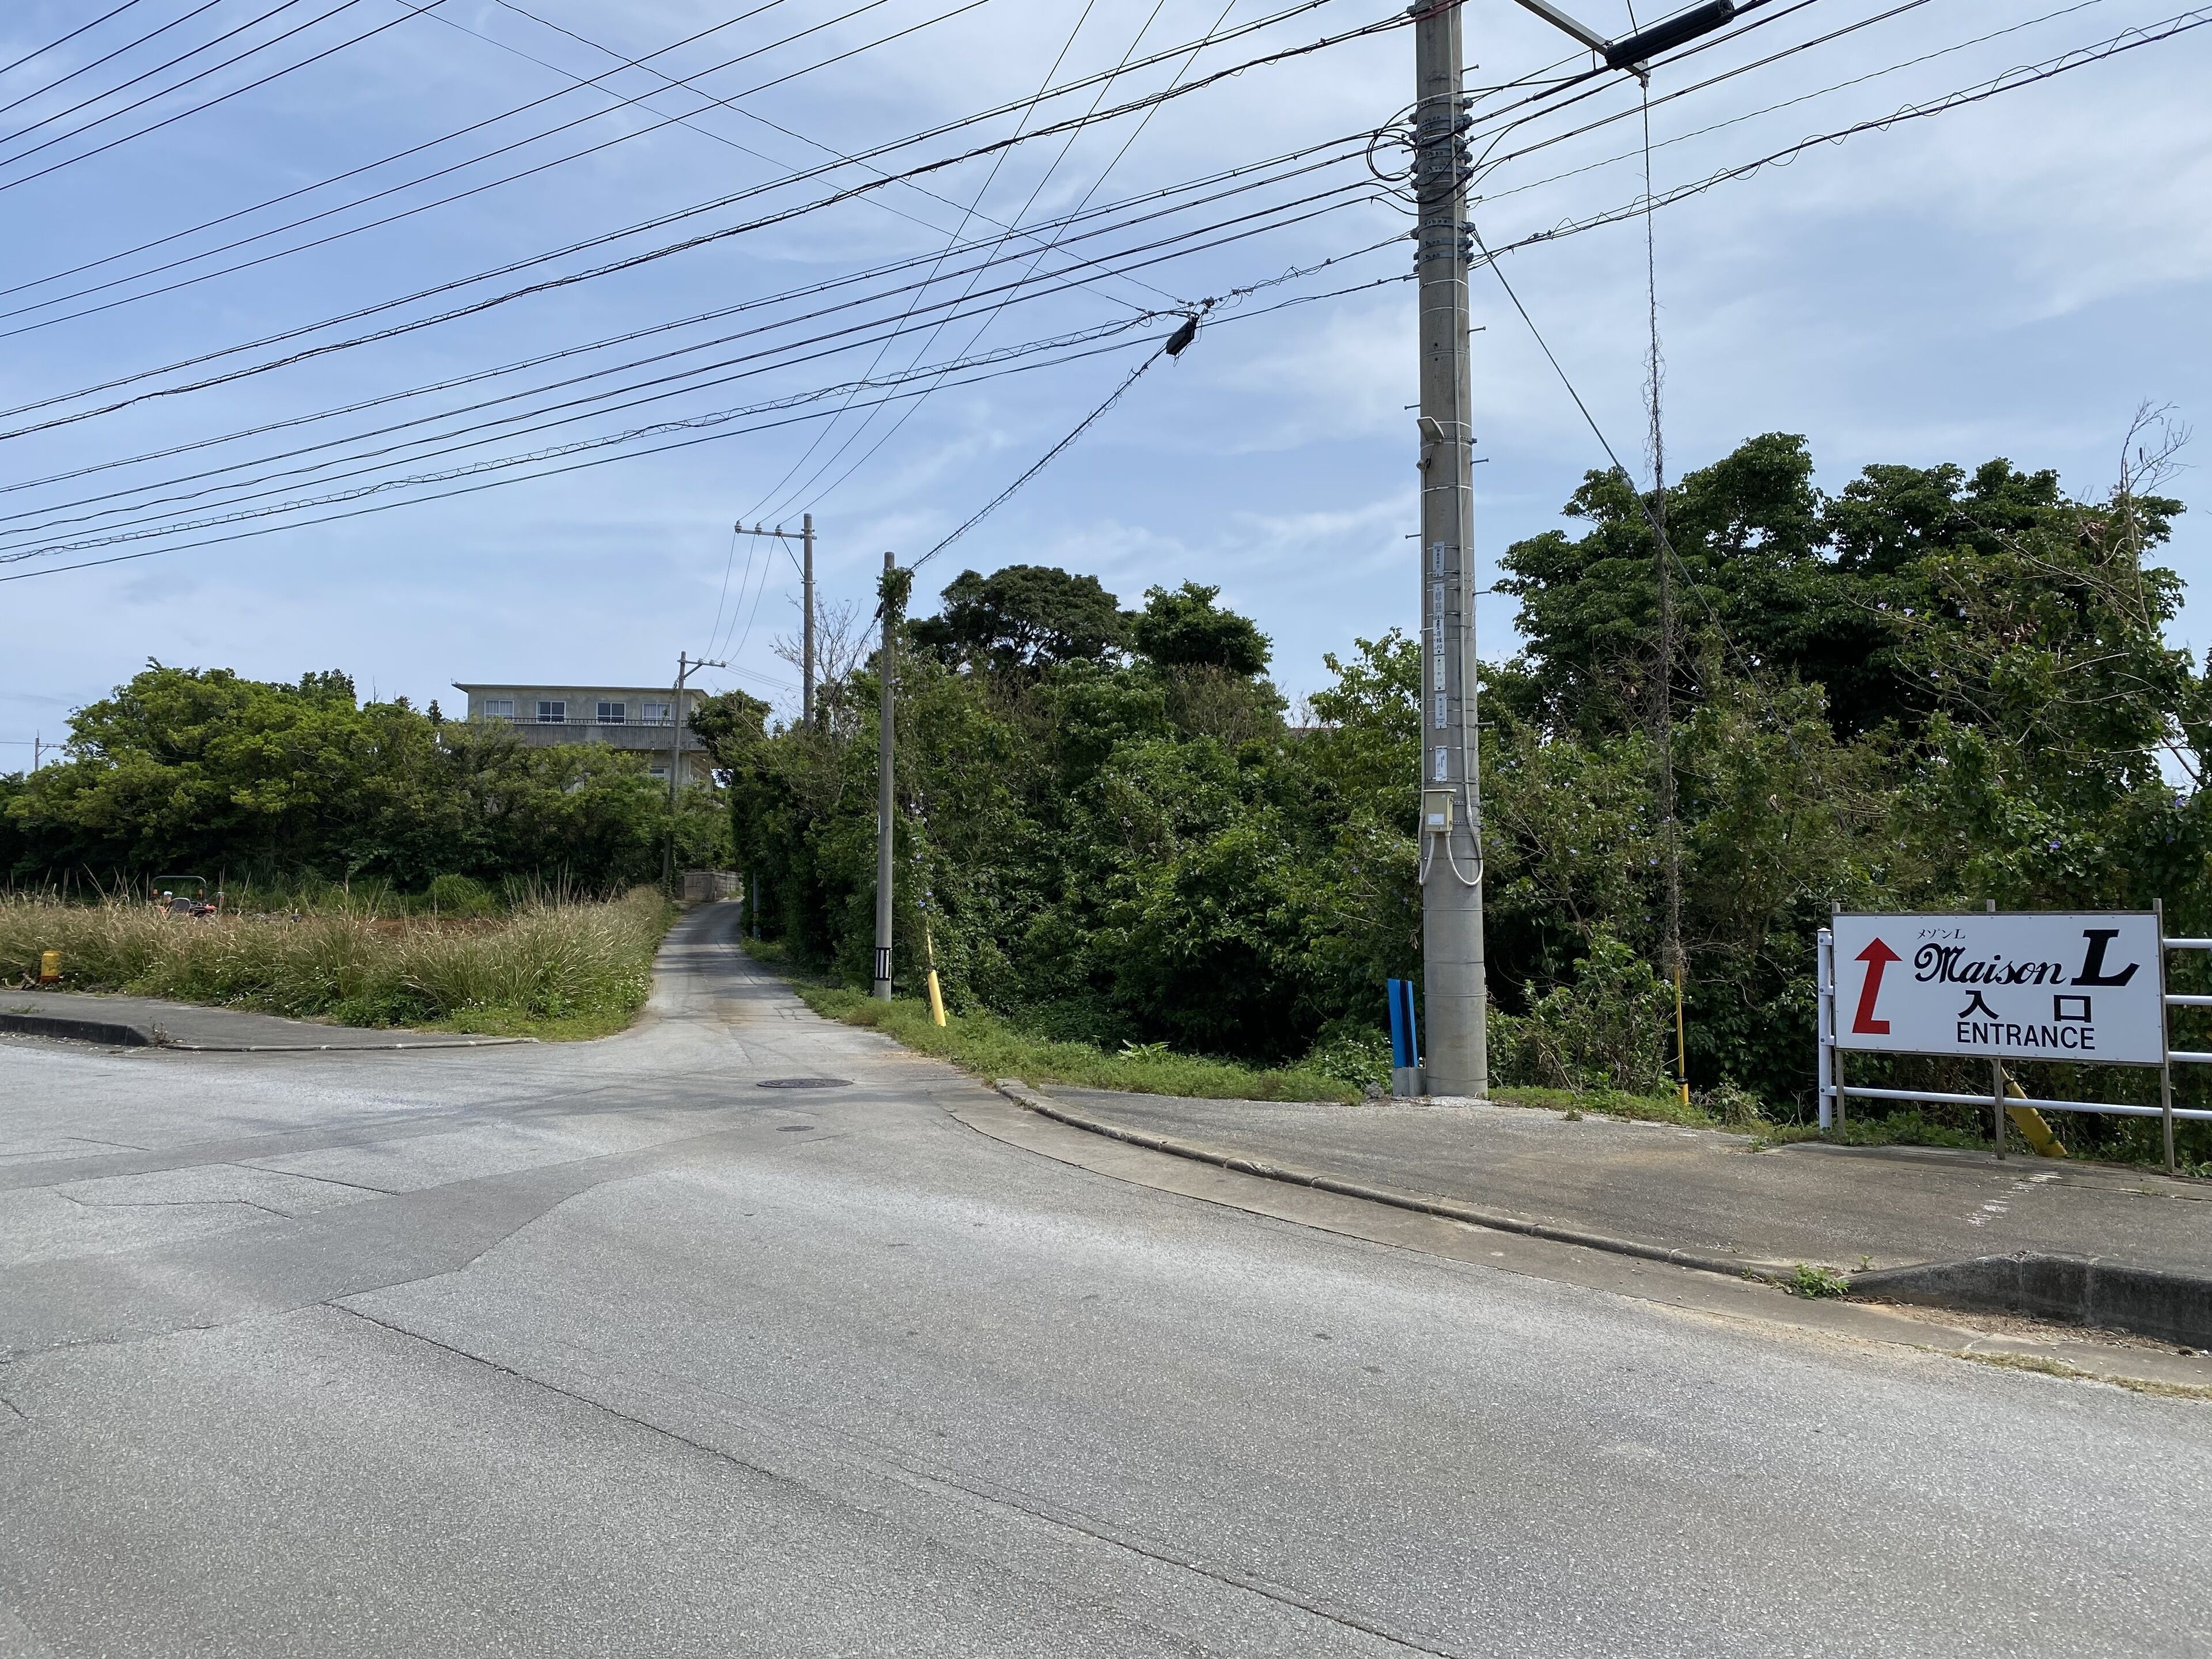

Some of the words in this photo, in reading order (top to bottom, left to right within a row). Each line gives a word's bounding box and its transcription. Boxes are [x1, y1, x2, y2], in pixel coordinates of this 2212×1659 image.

[1917, 928, 1965, 940] メゾンL
[1914, 943, 2067, 985] Maison
[2070, 929, 2141, 987] L
[1958, 990, 2092, 1023] 入口
[1957, 1021, 2096, 1050] ENTRANCE
